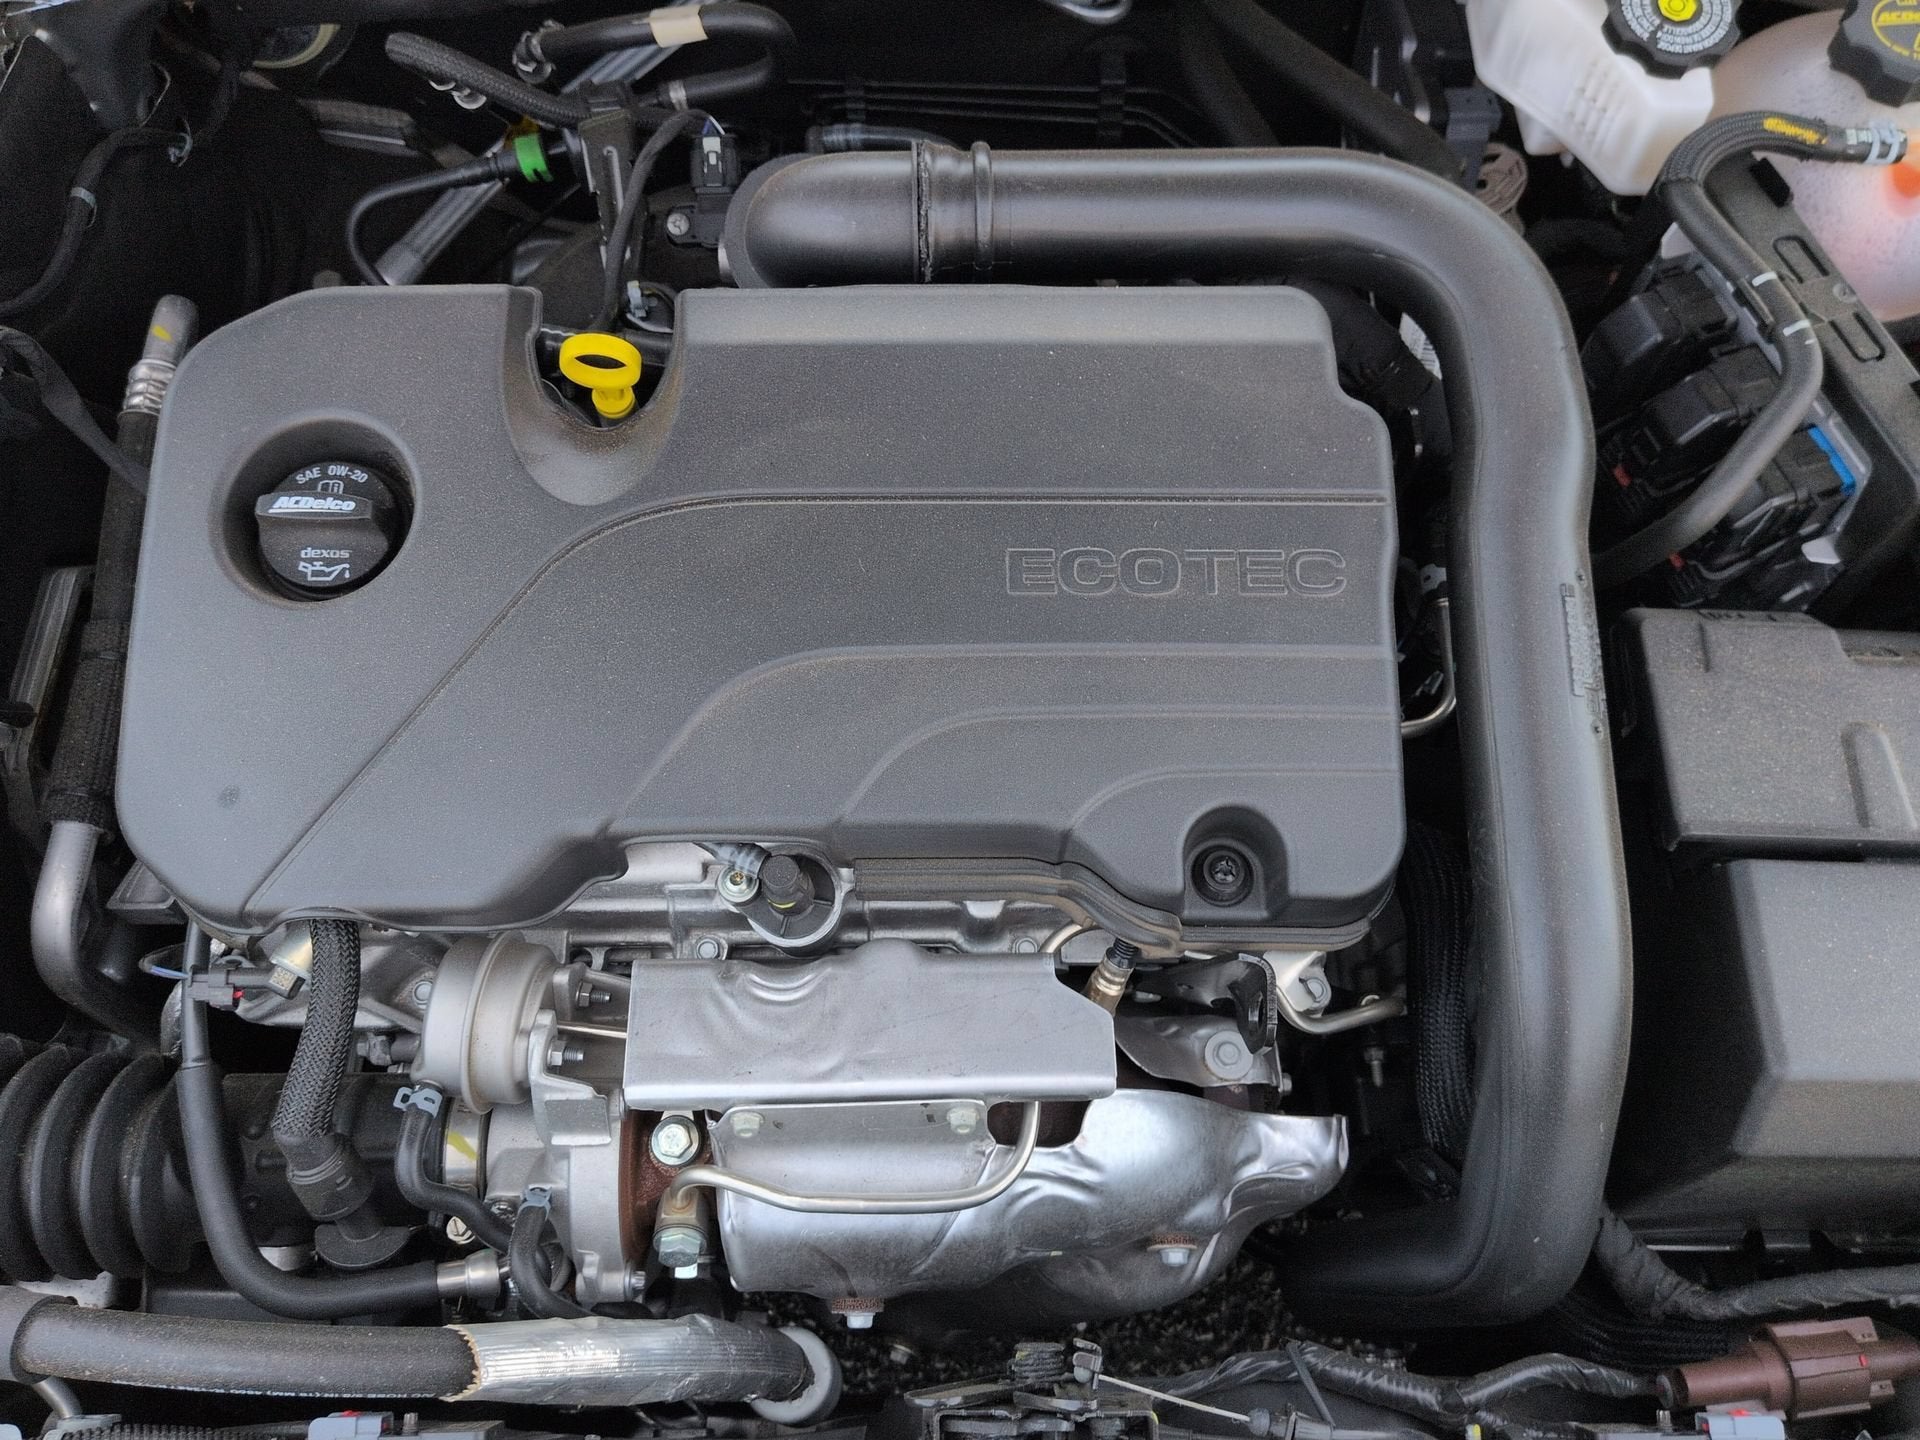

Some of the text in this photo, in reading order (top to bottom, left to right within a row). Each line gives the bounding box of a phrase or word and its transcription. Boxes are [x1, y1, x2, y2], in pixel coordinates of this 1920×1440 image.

[296, 465, 368, 484] SAE 0W-20
[272, 496, 356, 511] ACDelco
[300, 547, 351, 558] dexos
[1006, 547, 1347, 597] ECOTEC
